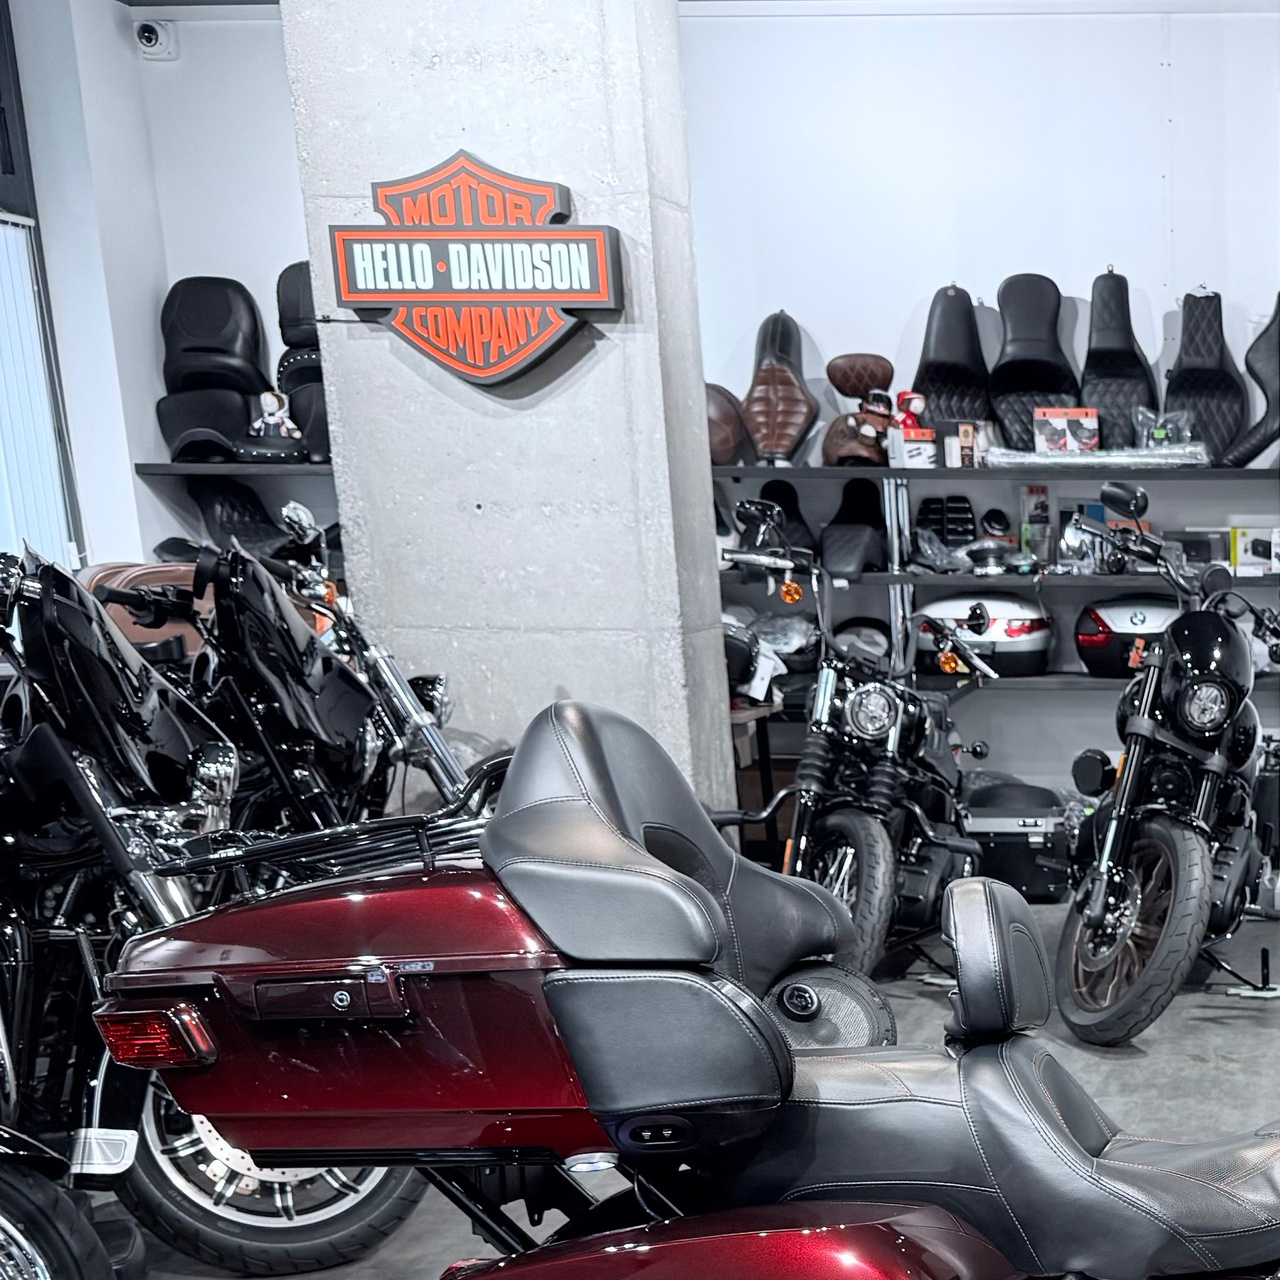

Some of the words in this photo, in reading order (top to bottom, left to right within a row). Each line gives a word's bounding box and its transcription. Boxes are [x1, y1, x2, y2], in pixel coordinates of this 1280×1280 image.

[402, 172, 533, 226] MOTOR
[353, 243, 434, 290] HELLO
[448, 243, 591, 290] DAVIDSON
[412, 306, 542, 366] COMPANY
